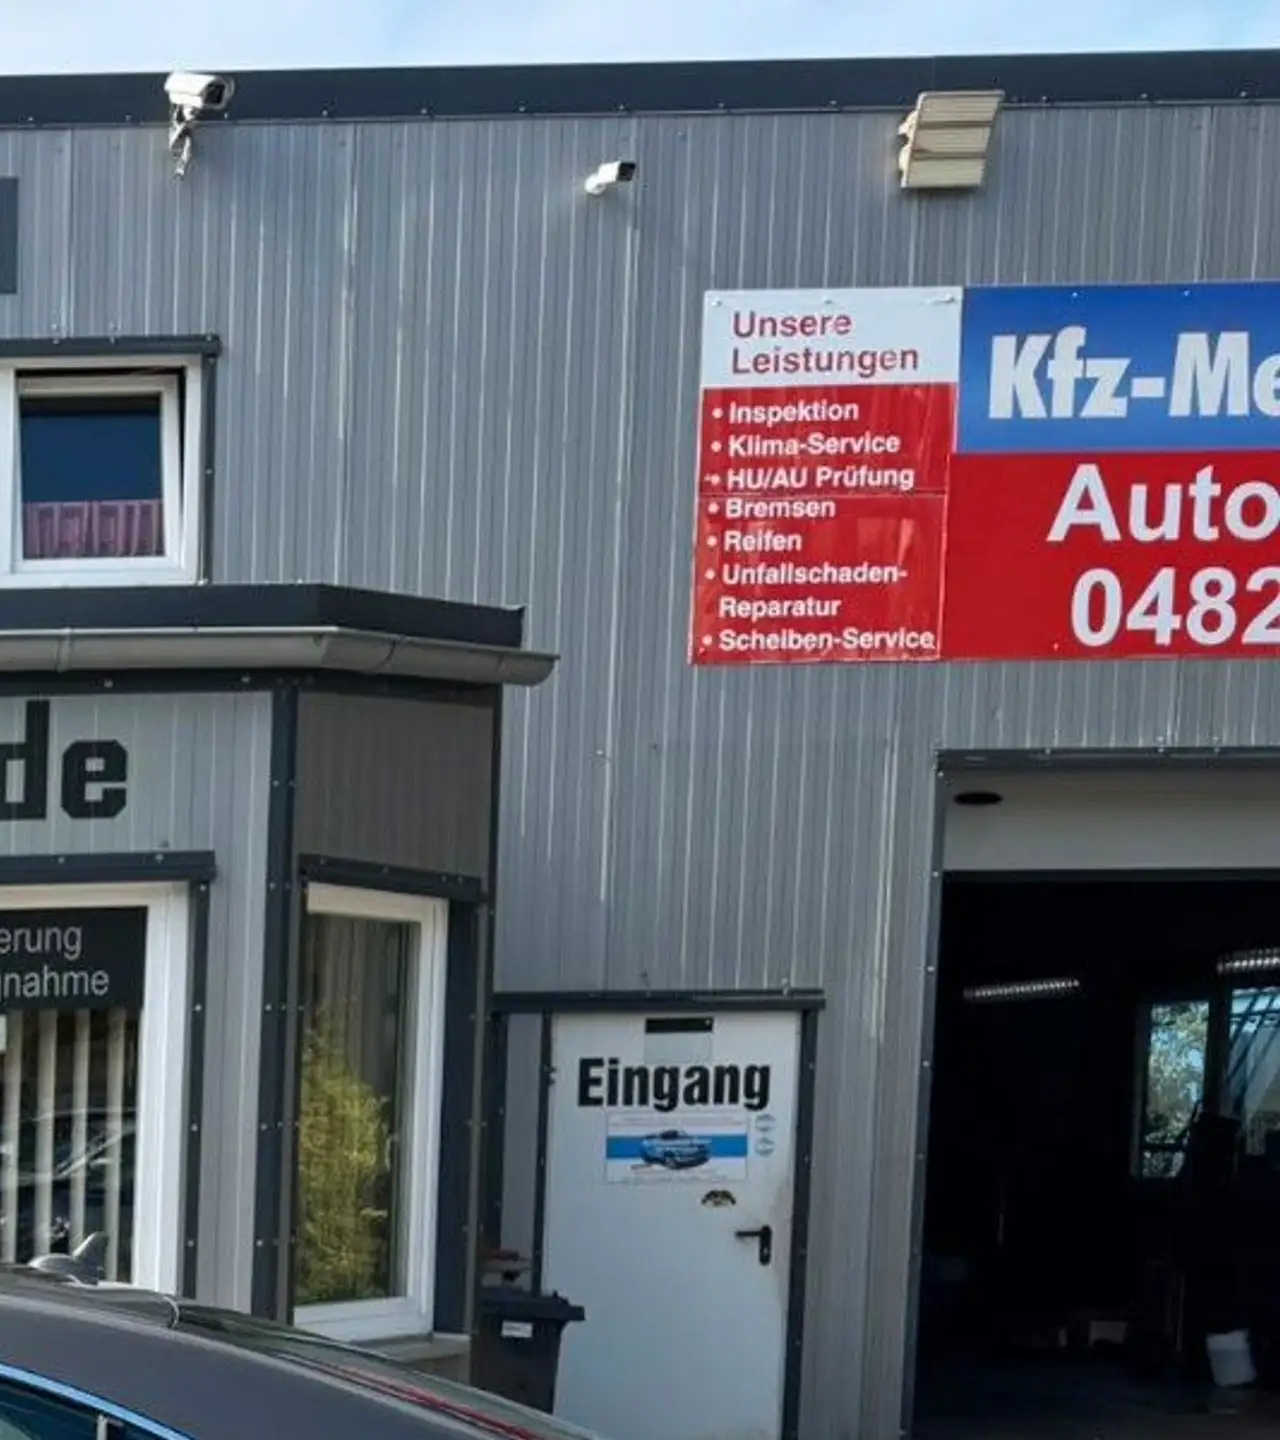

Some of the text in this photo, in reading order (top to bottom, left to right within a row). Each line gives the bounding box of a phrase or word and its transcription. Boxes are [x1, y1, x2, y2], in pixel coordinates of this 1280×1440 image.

[733, 310, 853, 338] Unsere
[732, 346, 919, 378] Leistungen
[728, 400, 860, 427] Inspektion
[727, 431, 901, 458] Klima-Service
[727, 465, 915, 491] HU/AU Prüfung
[724, 498, 836, 518] Bremsen
[1045, 462, 1280, 542] Auto
[723, 529, 803, 552] Reifen
[721, 561, 908, 586] Unfallschaden-
[718, 595, 842, 622] Reparatur
[1071, 566, 1280, 647] 0482
[718, 626, 937, 652] Scheiben-Service
[577, 1056, 772, 1113] Eingang
